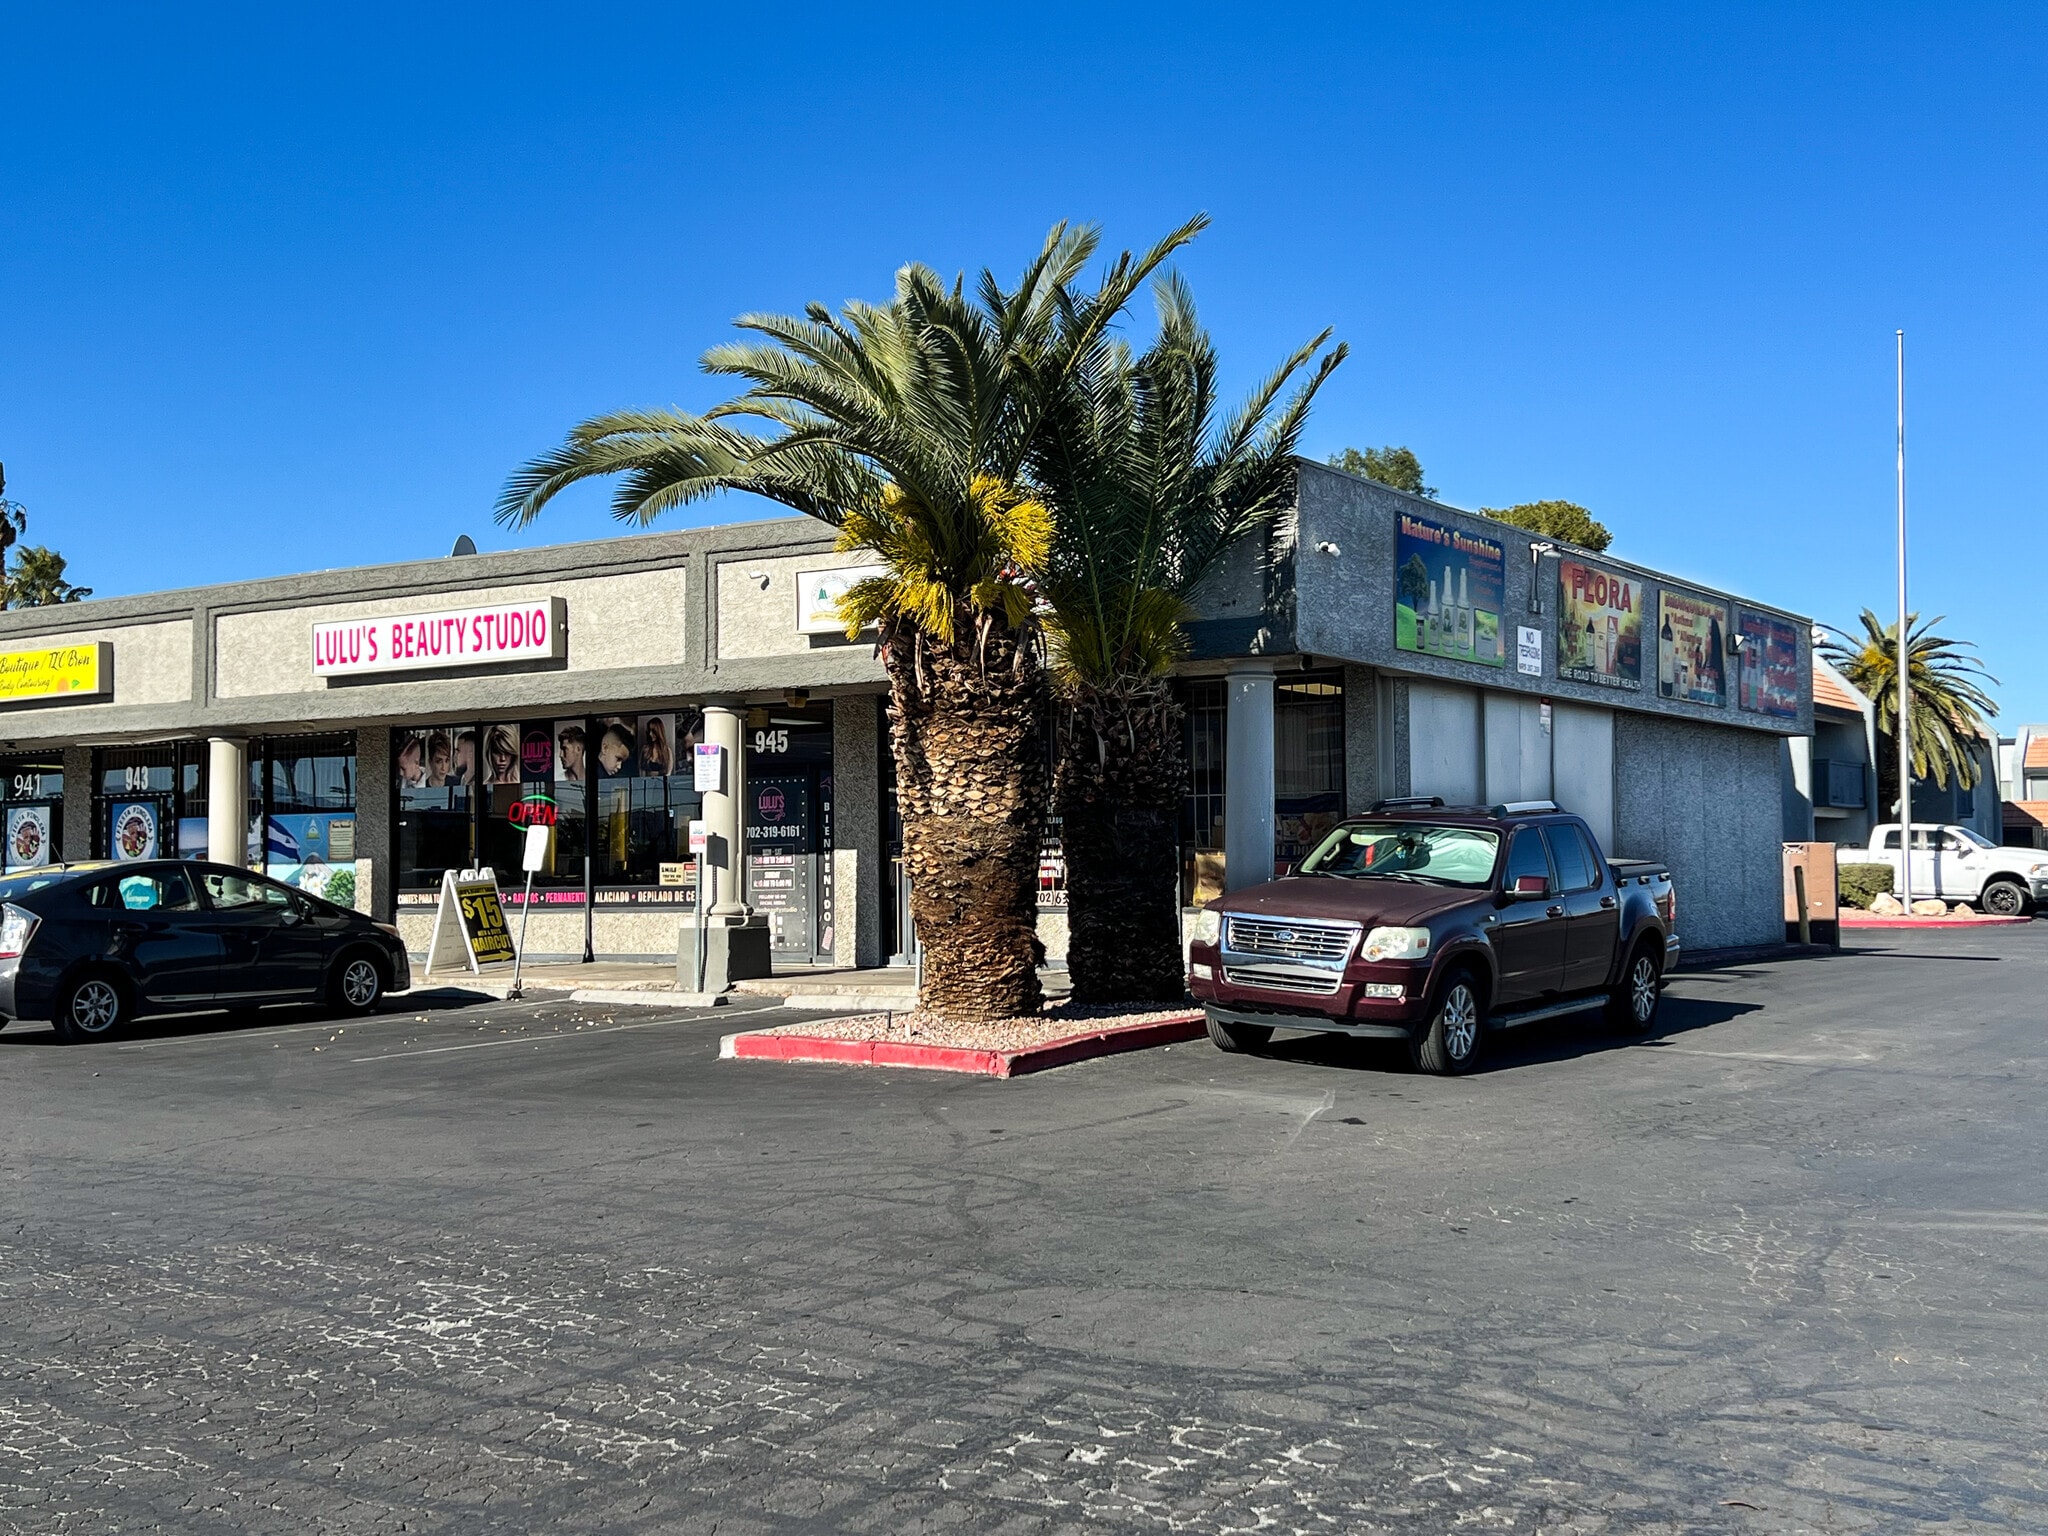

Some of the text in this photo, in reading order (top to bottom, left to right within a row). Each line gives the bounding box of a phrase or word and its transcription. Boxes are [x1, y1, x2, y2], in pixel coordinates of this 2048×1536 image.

[1401, 515, 1501, 560] Nature's Sunshine
[1571, 568, 1632, 613] FLORA
[316, 609, 546, 666] LULU'S BEAUTY STUDIO
[1525, 631, 1535, 644] NO
[0, 657, 39, 677] Boutique
[1560, 666, 1640, 689] THE ROAD TO BETTER HEALTH
[521, 742, 551, 758] LULU'S
[755, 730, 788, 753] 945
[14, 773, 40, 797] 941
[125, 766, 149, 791] 943
[508, 802, 558, 825] OPEN
[759, 796, 784, 810] LULU'S
[746, 825, 800, 838] 702-319-6161
[823, 802, 831, 921] BIENVENIDO
[397, 894, 417, 905] CORTES
[418, 894, 433, 905] PARA
[513, 893, 539, 904] RAYOS
[595, 890, 696, 904] ALACIADO DEPILADO DE CE
[462, 896, 503, 929] $15
[471, 934, 512, 952] HAIRCUT
